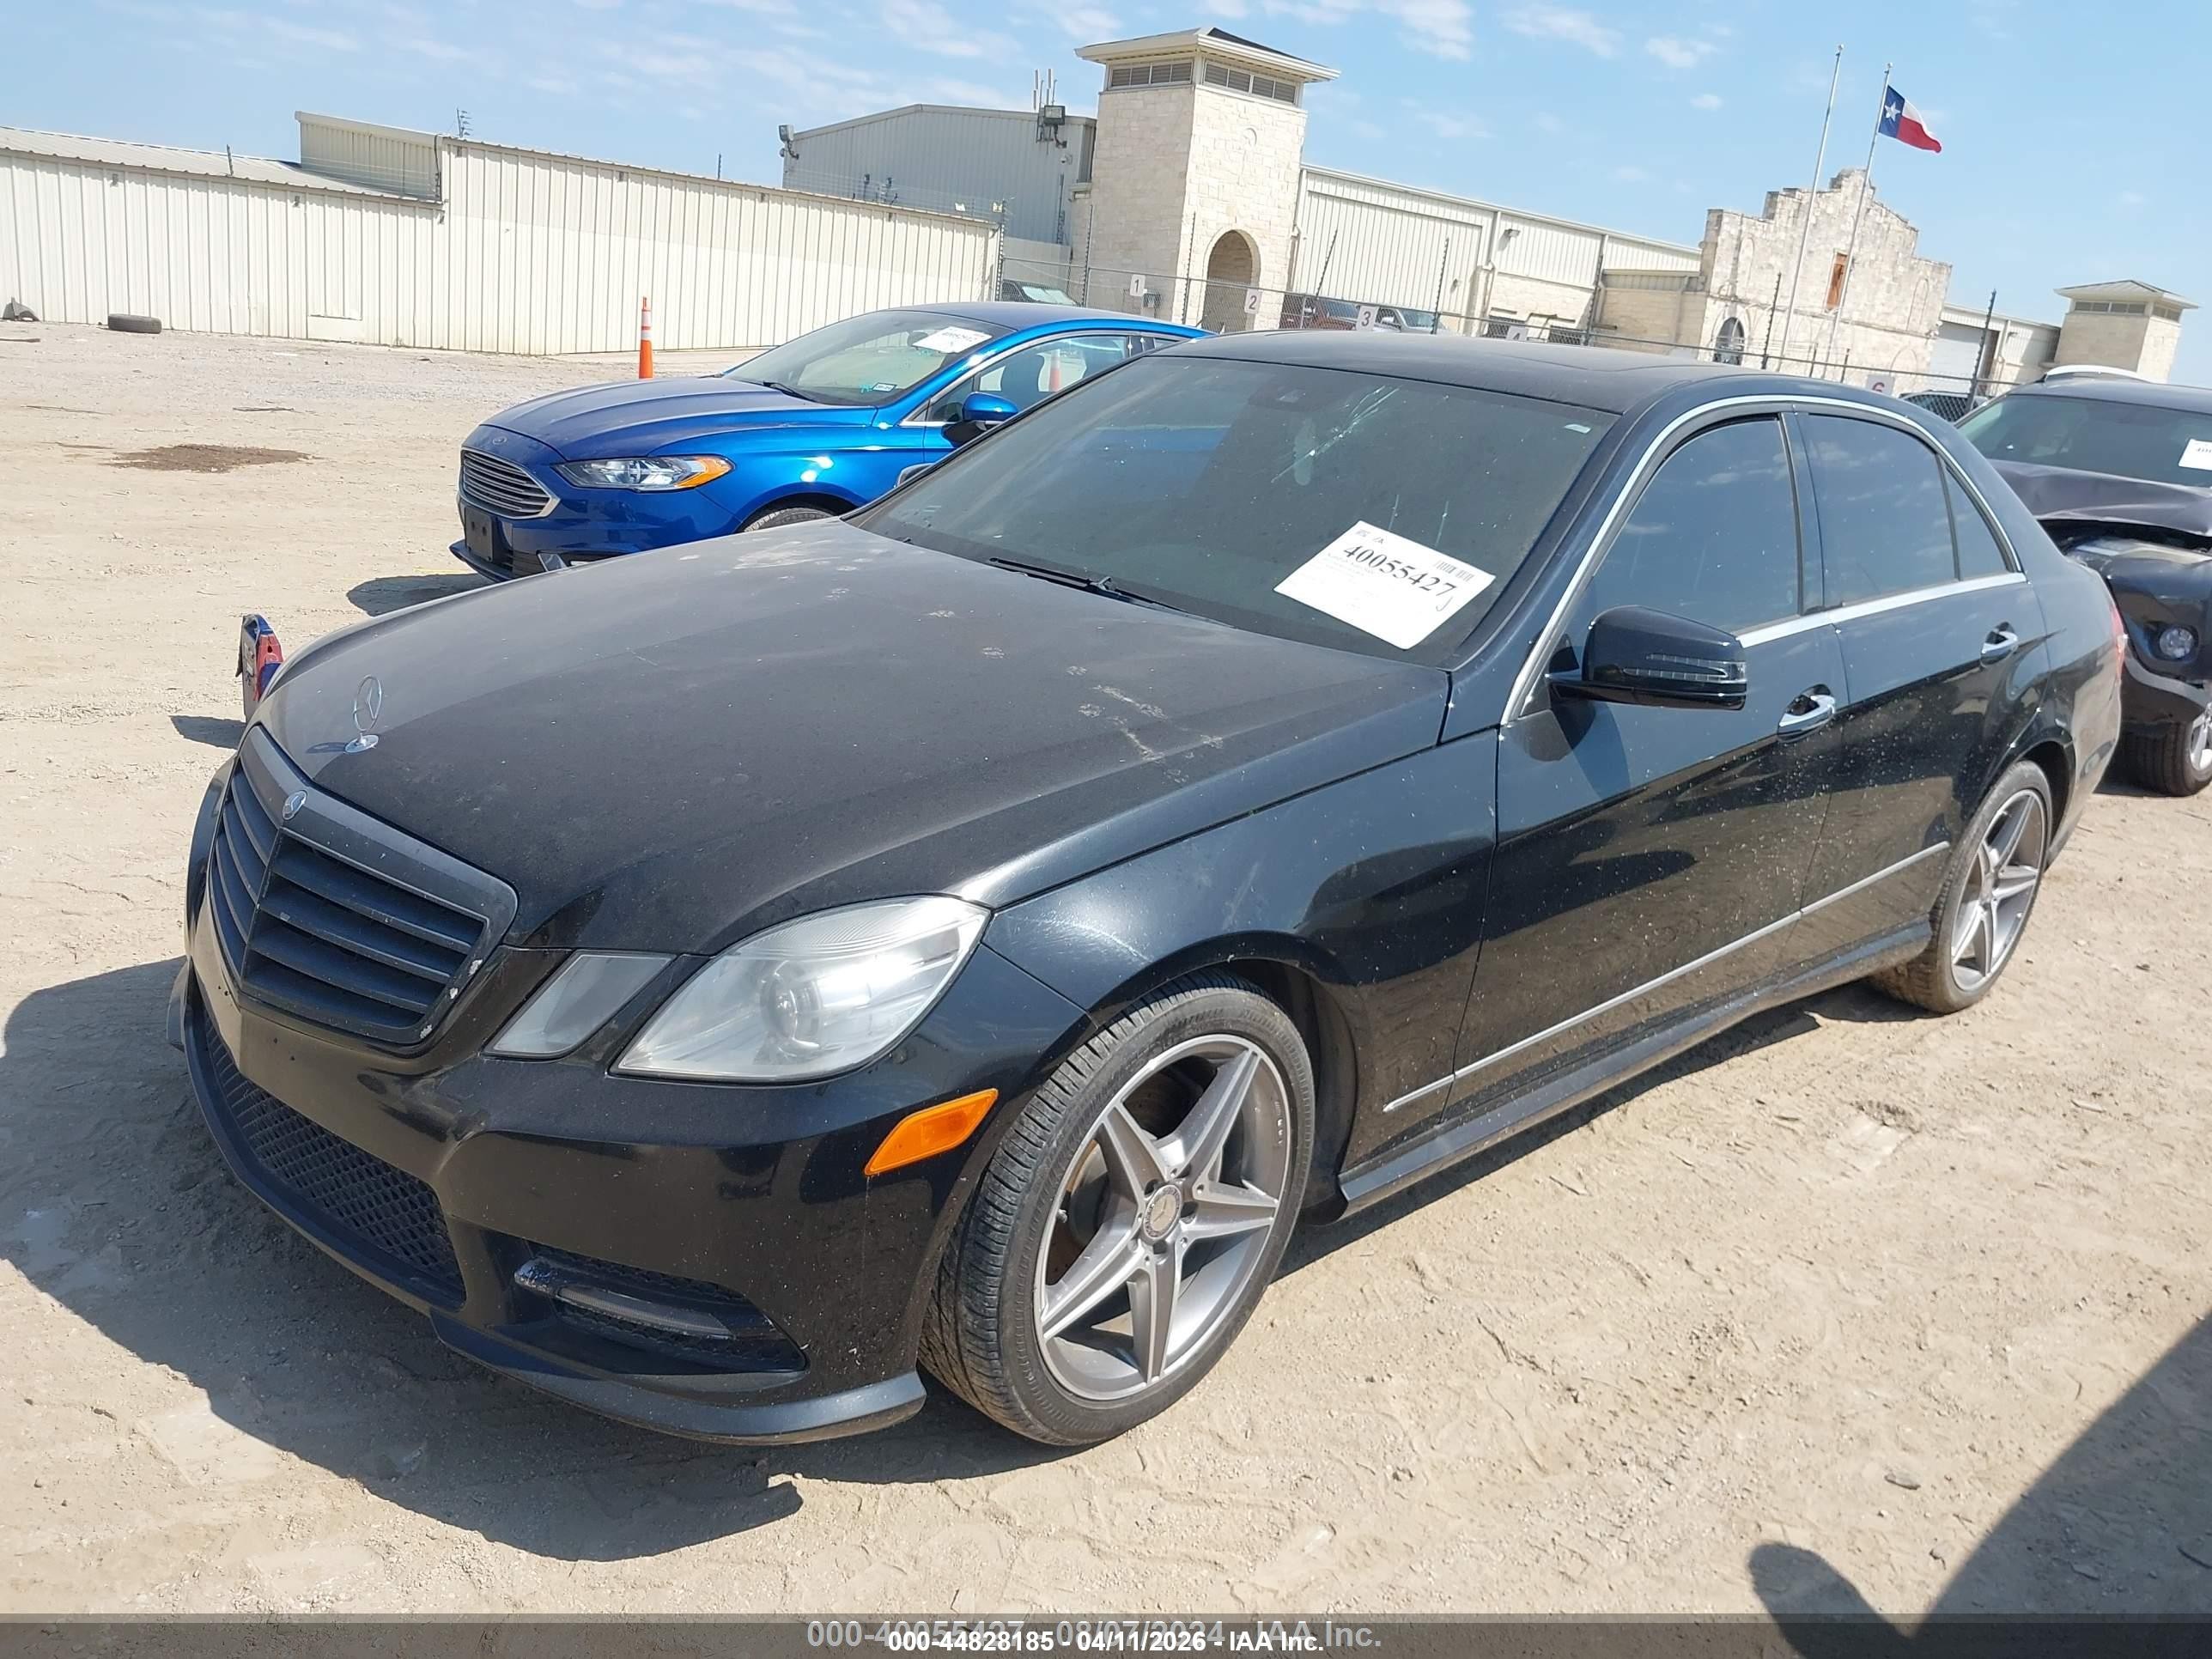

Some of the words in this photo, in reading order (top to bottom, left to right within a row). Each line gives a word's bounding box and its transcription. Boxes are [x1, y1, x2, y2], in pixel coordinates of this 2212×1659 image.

[1133, 278, 1140, 293] 1
[1249, 295, 1257, 310] 2
[1361, 310, 1371, 327] 3
[1343, 545, 1457, 596] 40055427
